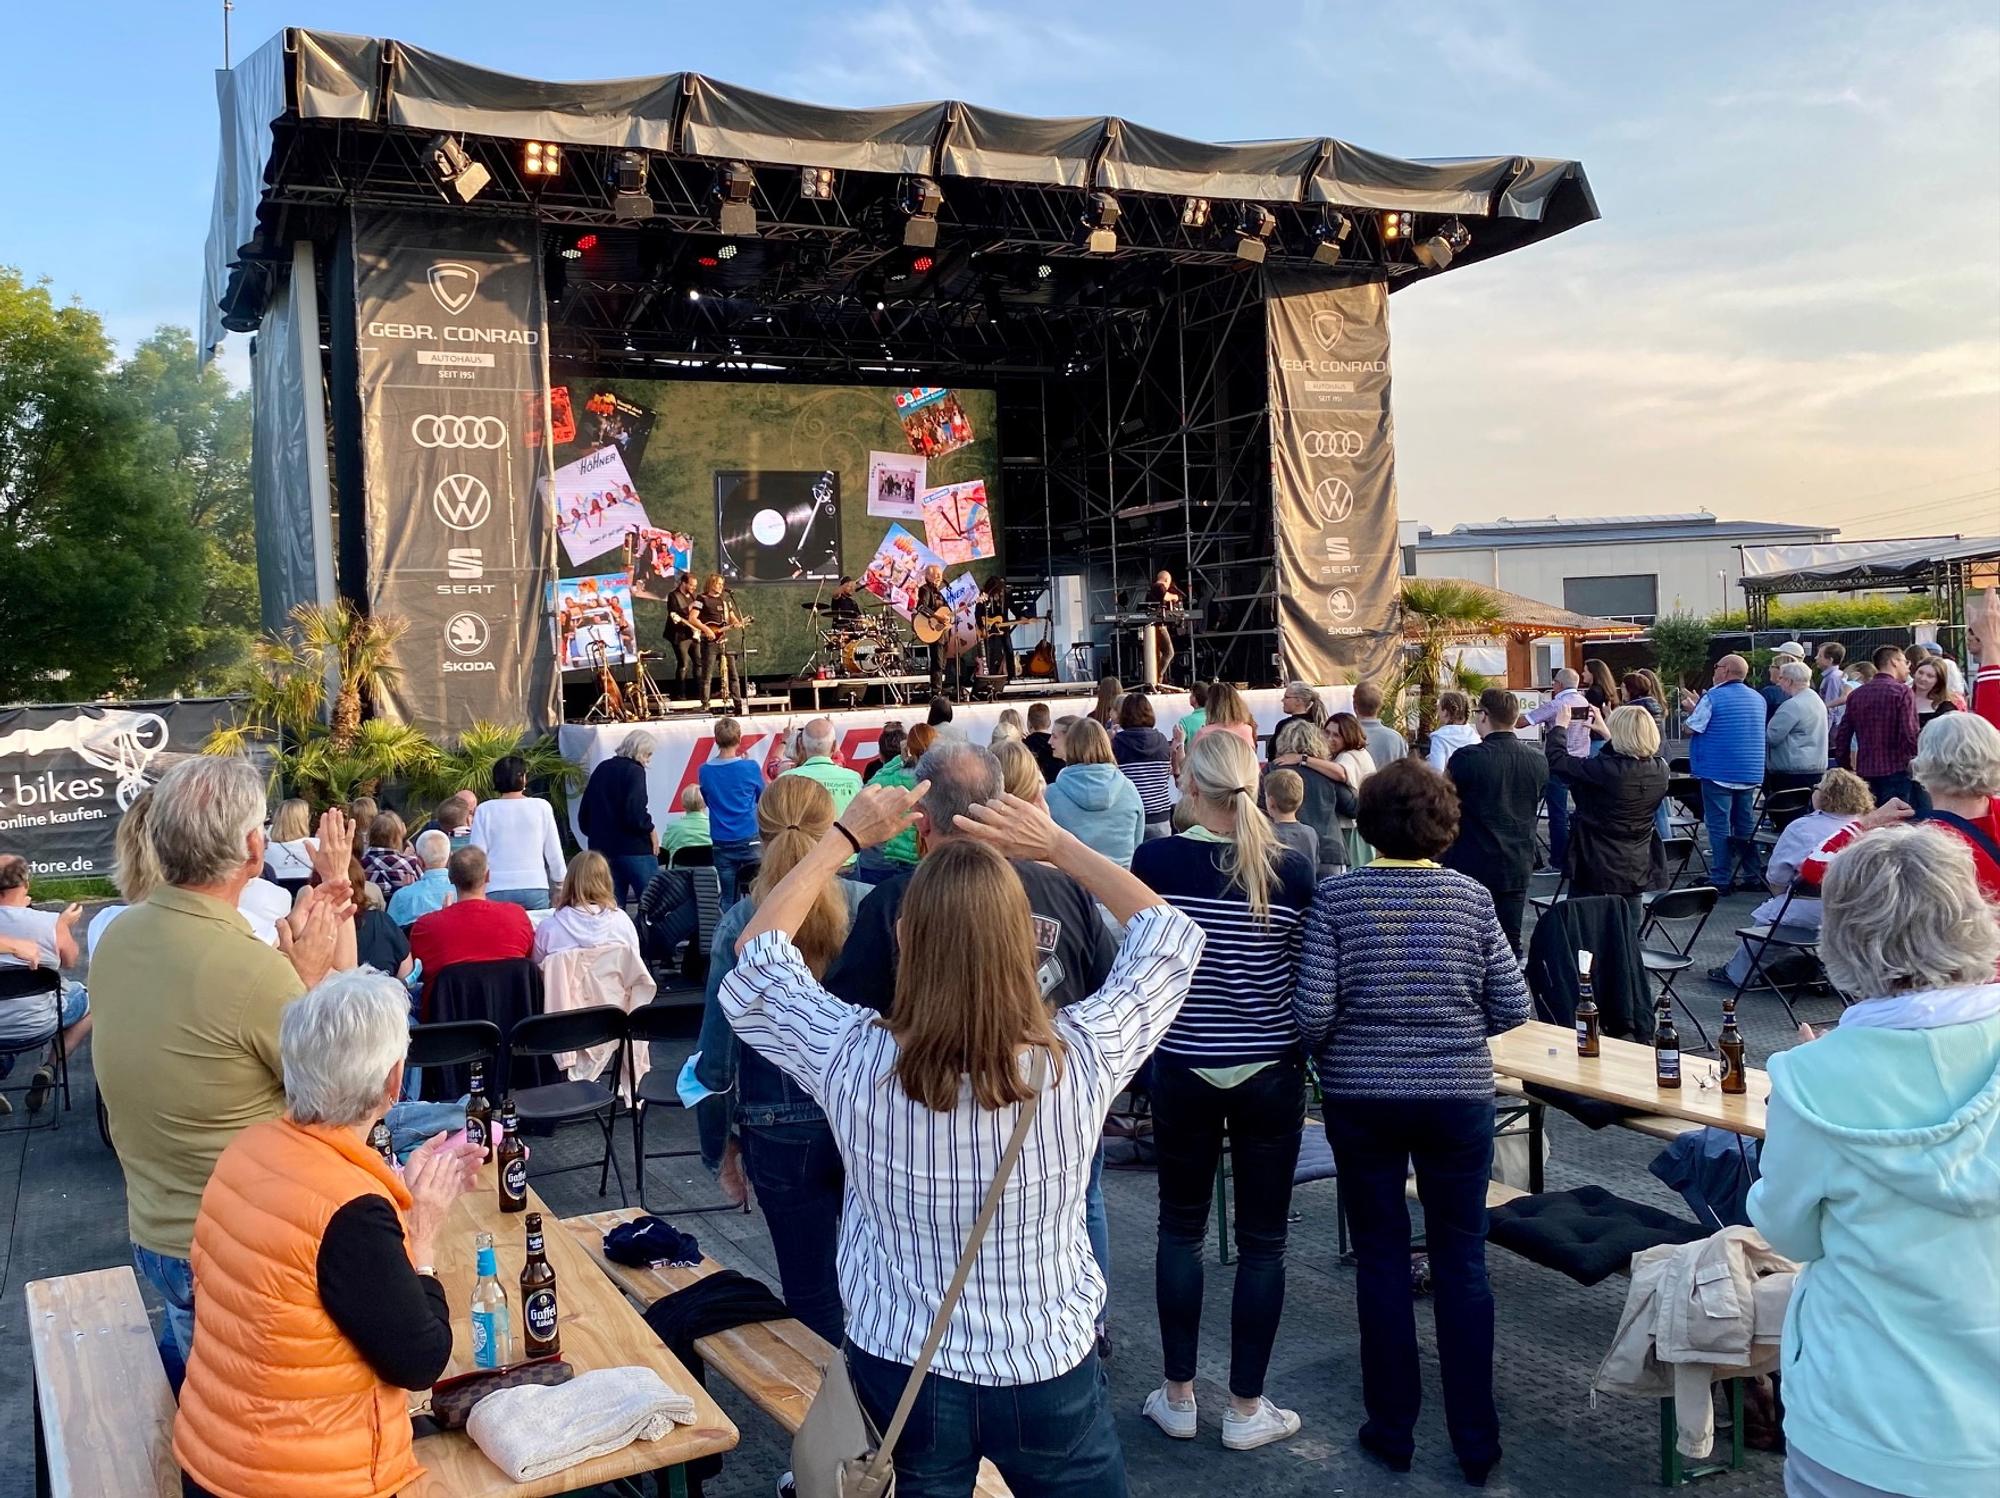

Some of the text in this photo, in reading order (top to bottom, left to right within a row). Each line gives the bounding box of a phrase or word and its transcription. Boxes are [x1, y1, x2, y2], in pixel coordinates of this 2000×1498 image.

[368, 321, 539, 345] GEBR. CONRAD
[430, 354, 482, 364] AUTOHAUS
[1320, 360, 1386, 373] CONRAD
[438, 370, 475, 380] SEIT 1951
[1321, 565, 1360, 574] SEAT
[437, 585, 496, 594] SEAT
[442, 661, 496, 672] ŠKODA
[14, 771, 105, 806] bikes
[0, 806, 108, 830] online kaufen.
[29, 855, 93, 873] tore.de
[530, 1303, 557, 1320] Gaffel
